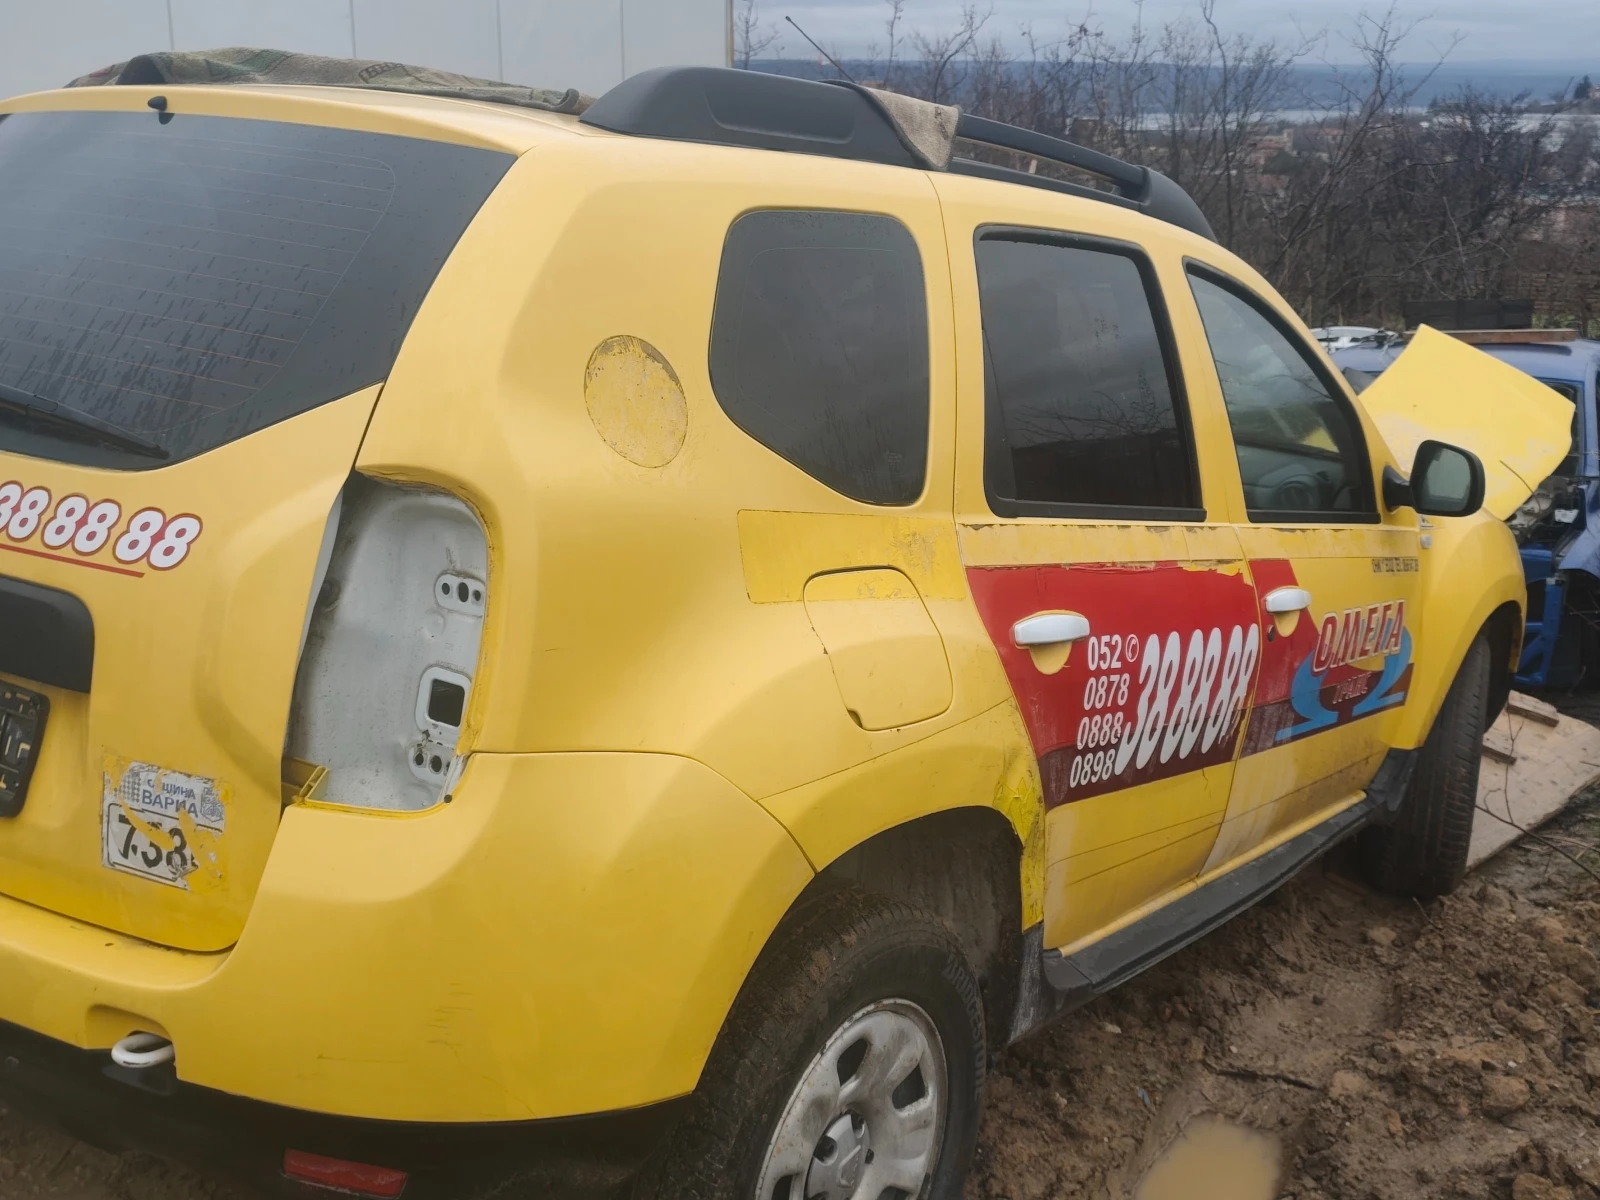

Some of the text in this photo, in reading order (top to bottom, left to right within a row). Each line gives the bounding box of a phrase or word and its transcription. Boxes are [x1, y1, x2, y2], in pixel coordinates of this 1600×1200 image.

[1087, 634, 1122, 671] 052
[1313, 600, 1405, 673] ОМЕГА
[1083, 673, 1130, 710] 0878
[1076, 711, 1124, 750] 0888
[1069, 749, 1116, 788] 0898
